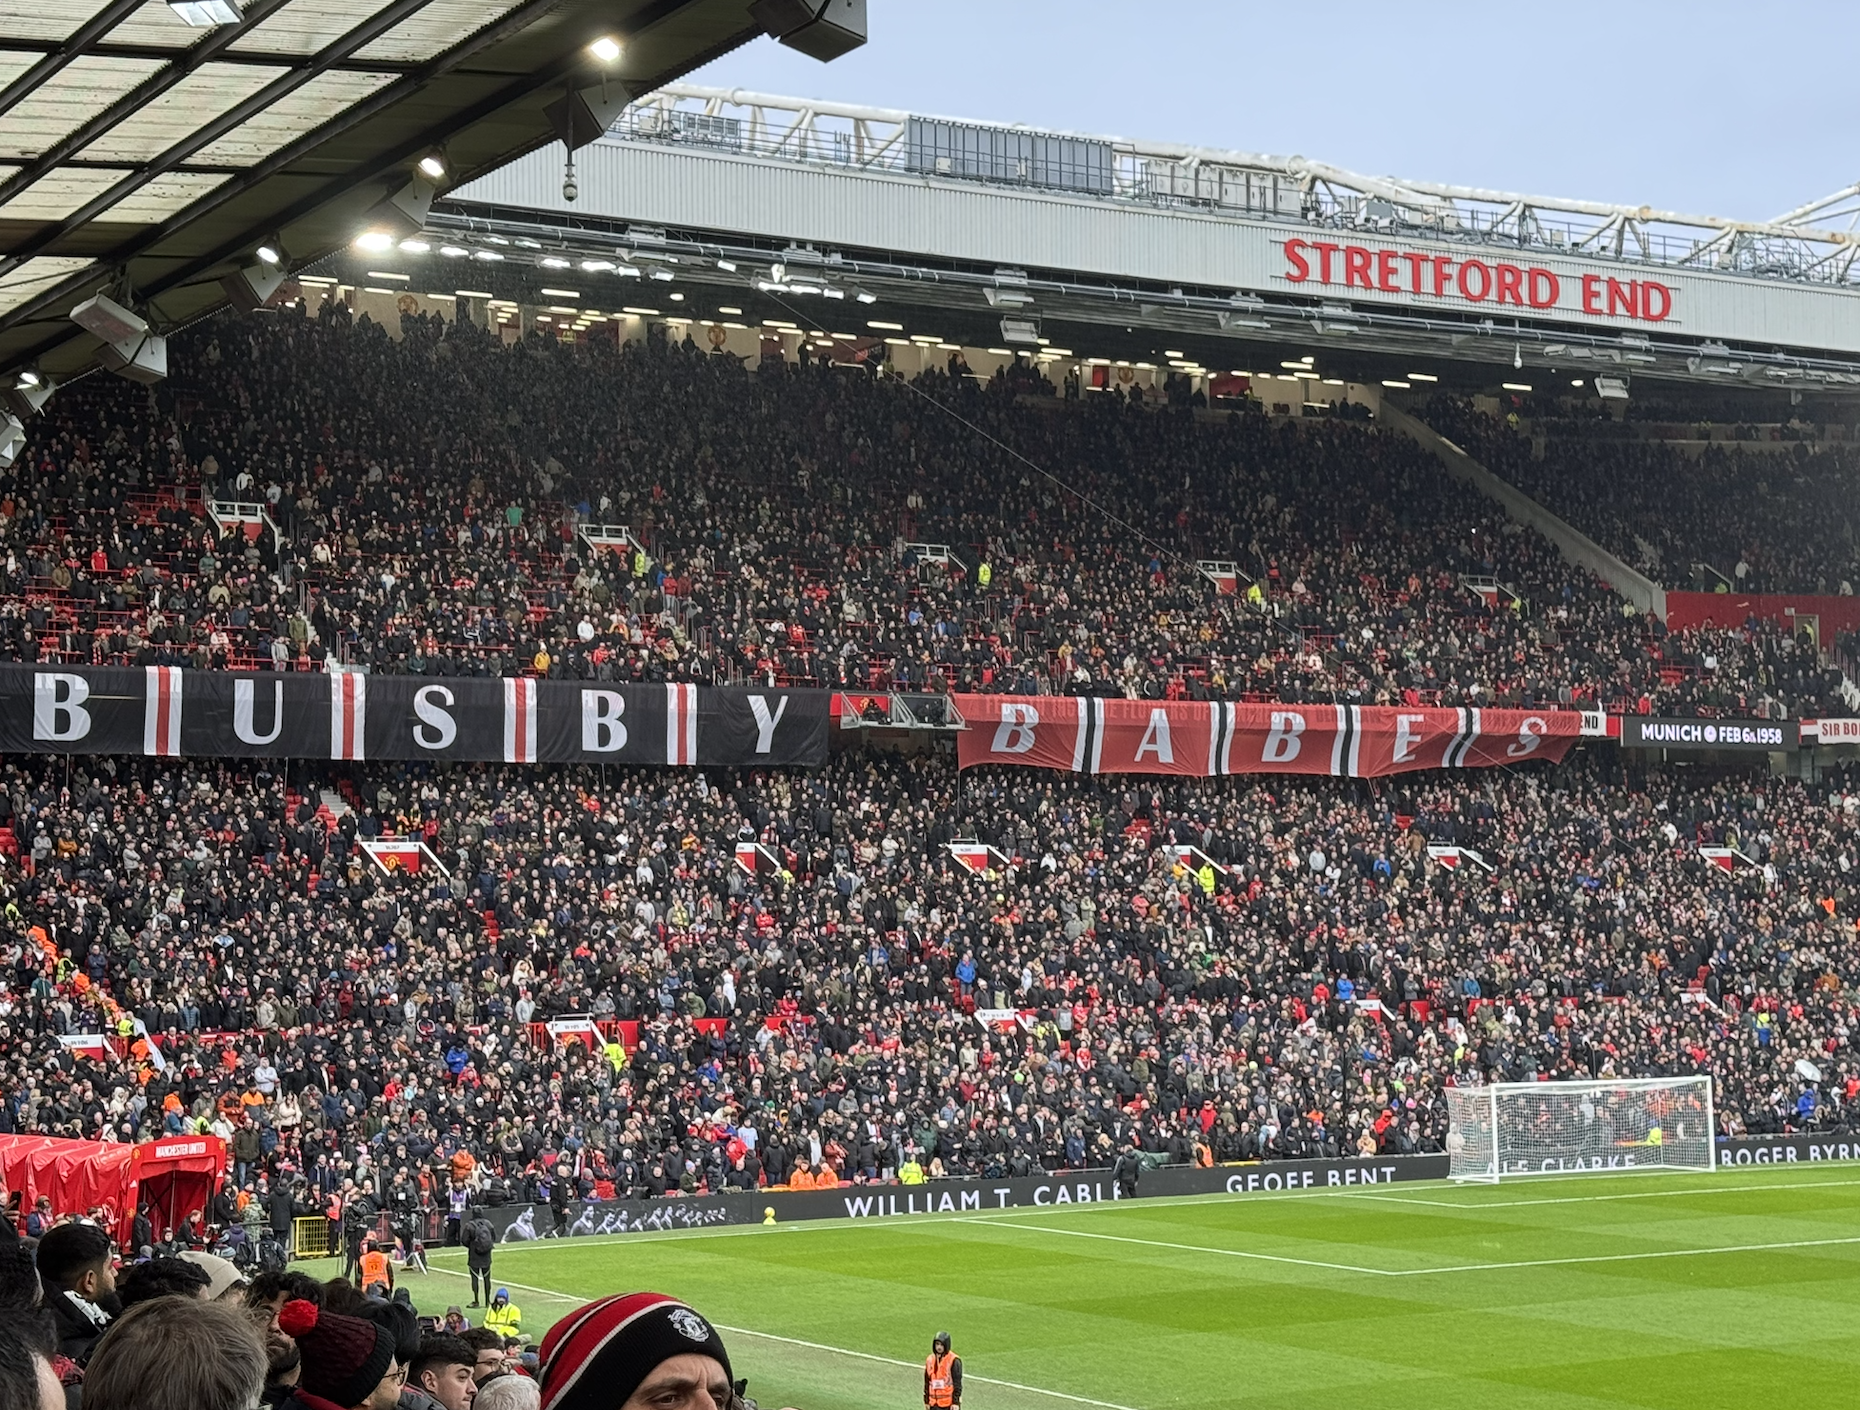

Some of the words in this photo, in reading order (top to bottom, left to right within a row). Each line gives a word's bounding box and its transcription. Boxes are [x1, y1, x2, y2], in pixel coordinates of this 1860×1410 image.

[1284, 238, 1559, 309] STRETFORD
[1581, 274, 1672, 322] END
[1641, 723, 1701, 742] MUNICH
[1719, 726, 1741, 743] FEB
[1756, 727, 1783, 745] 1958
[1822, 722, 1840, 736] SIR
[1843, 722, 1860, 736] BO
[155, 1143, 188, 1158] MANCHESTER
[188, 1141, 206, 1154] UNITED
[1721, 1146, 1798, 1166] ROGER
[1226, 1170, 1314, 1193] GEOFF
[1327, 1166, 1397, 1187] BENT
[844, 1190, 980, 1218] WILLIAM
